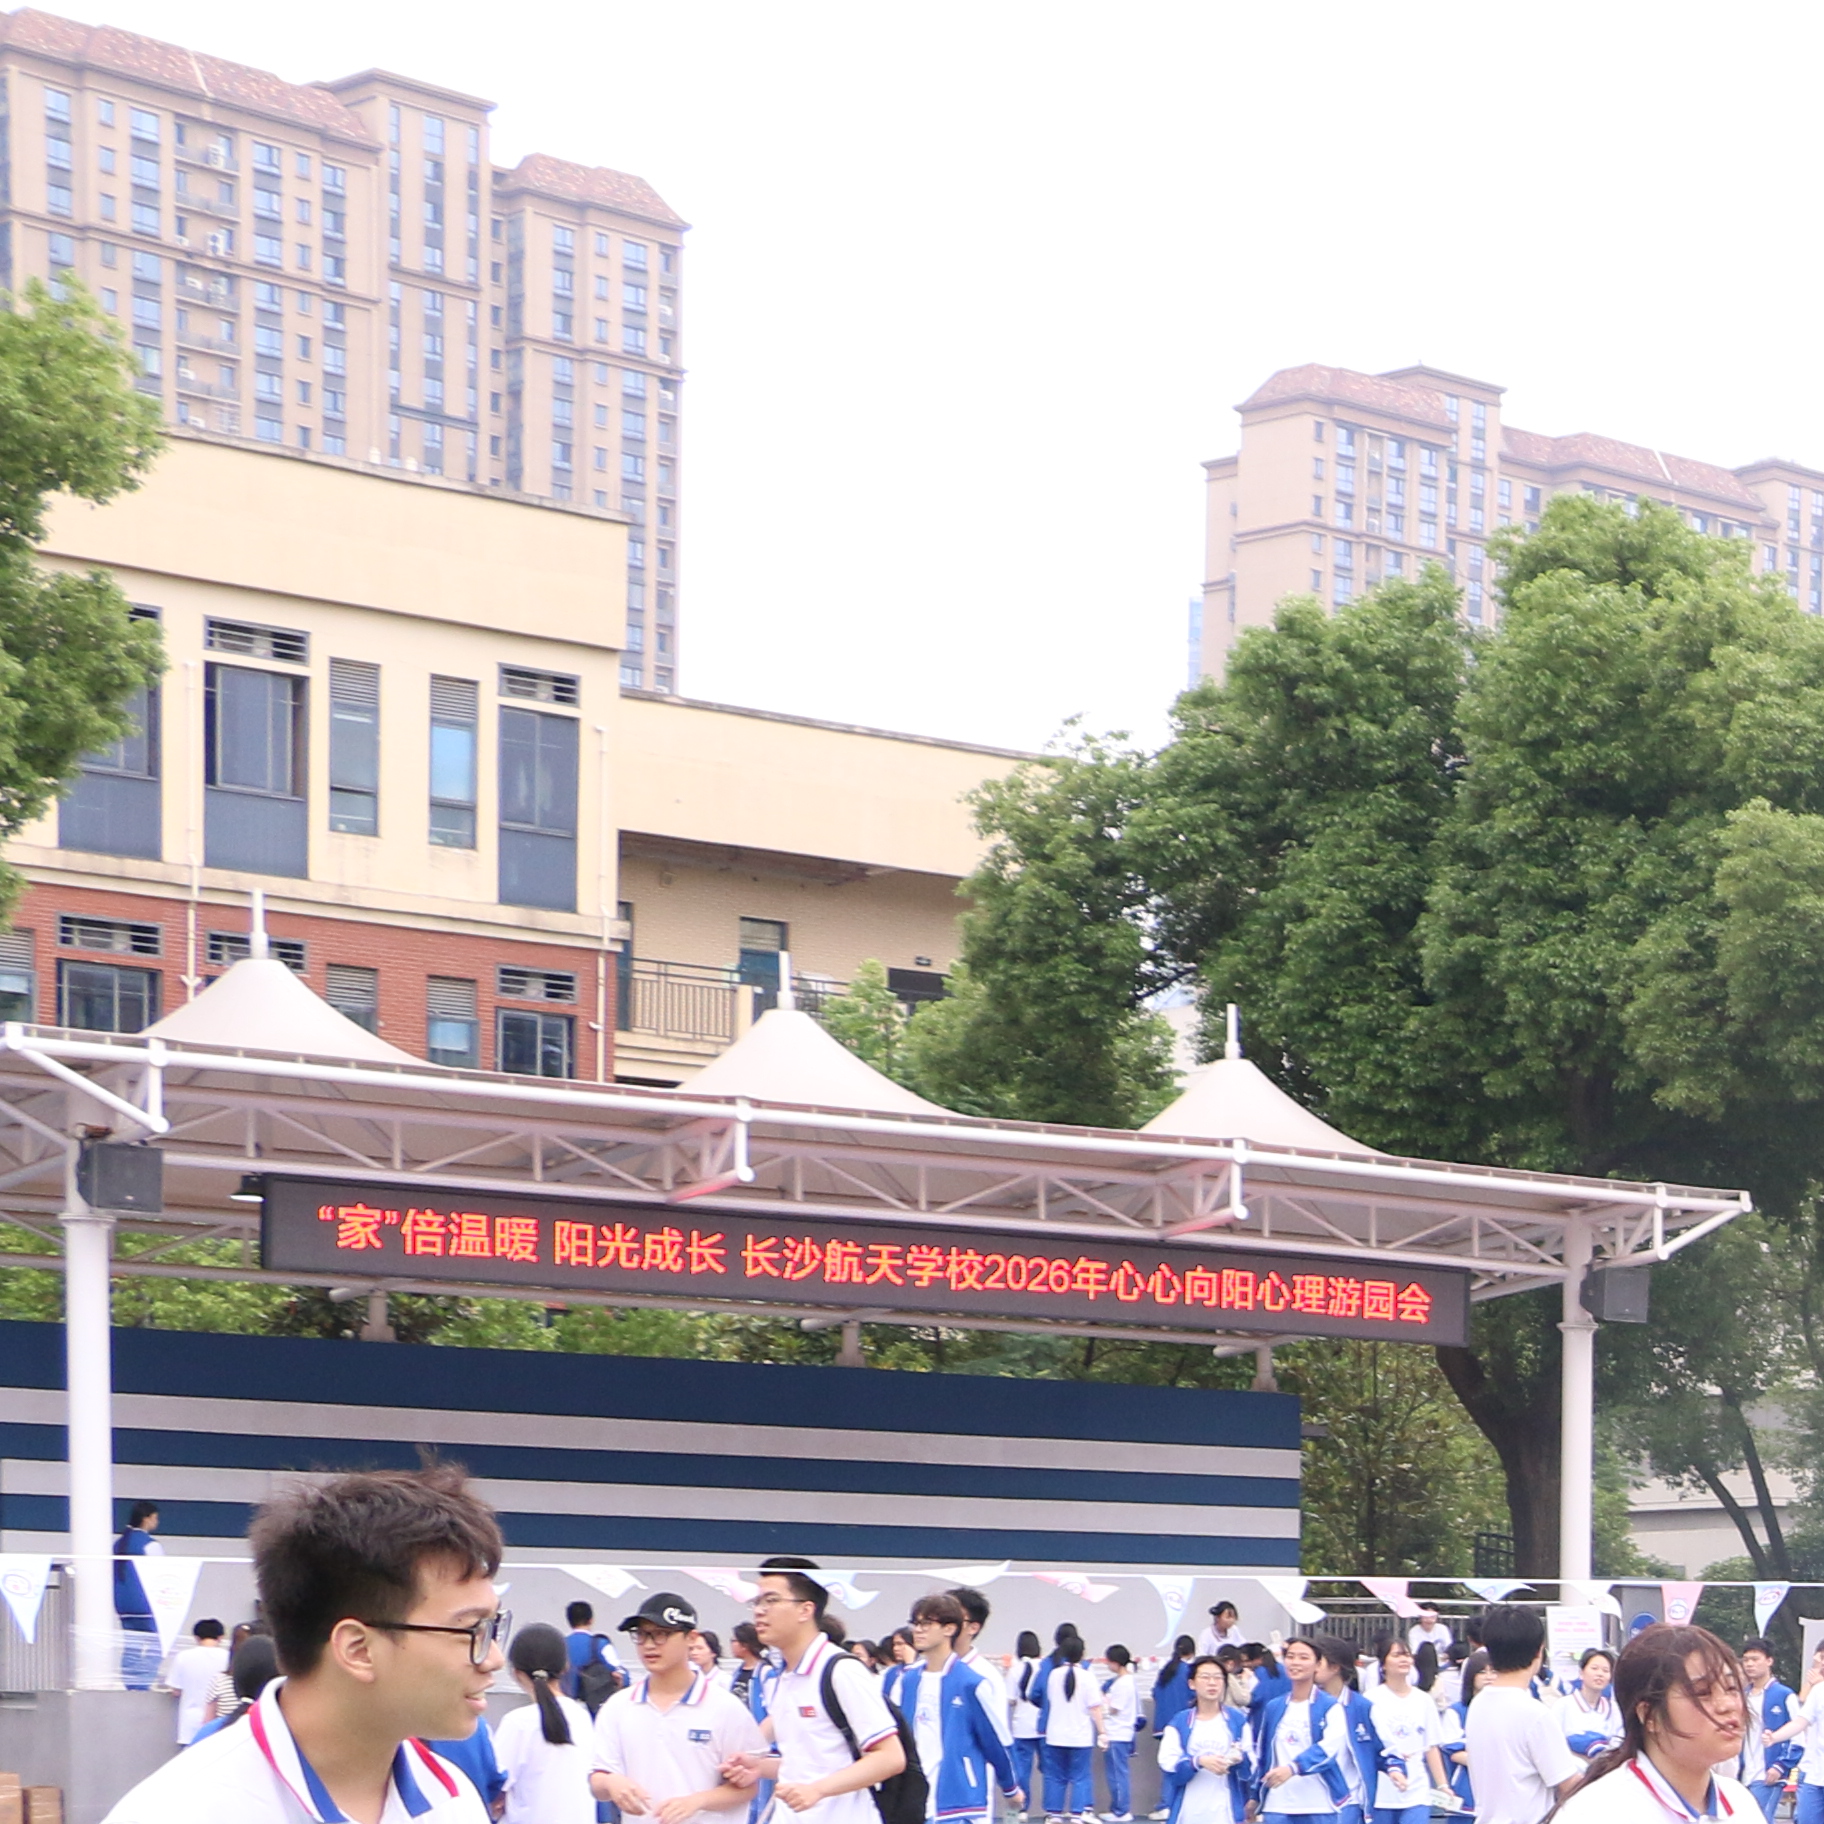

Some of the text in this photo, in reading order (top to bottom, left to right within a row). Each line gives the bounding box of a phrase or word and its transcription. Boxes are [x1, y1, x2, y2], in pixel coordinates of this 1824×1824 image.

[318, 1203, 1433, 1324] “家”倍温暖 阳光成长 长沙航天学校2026年心心向阳心理游园会
